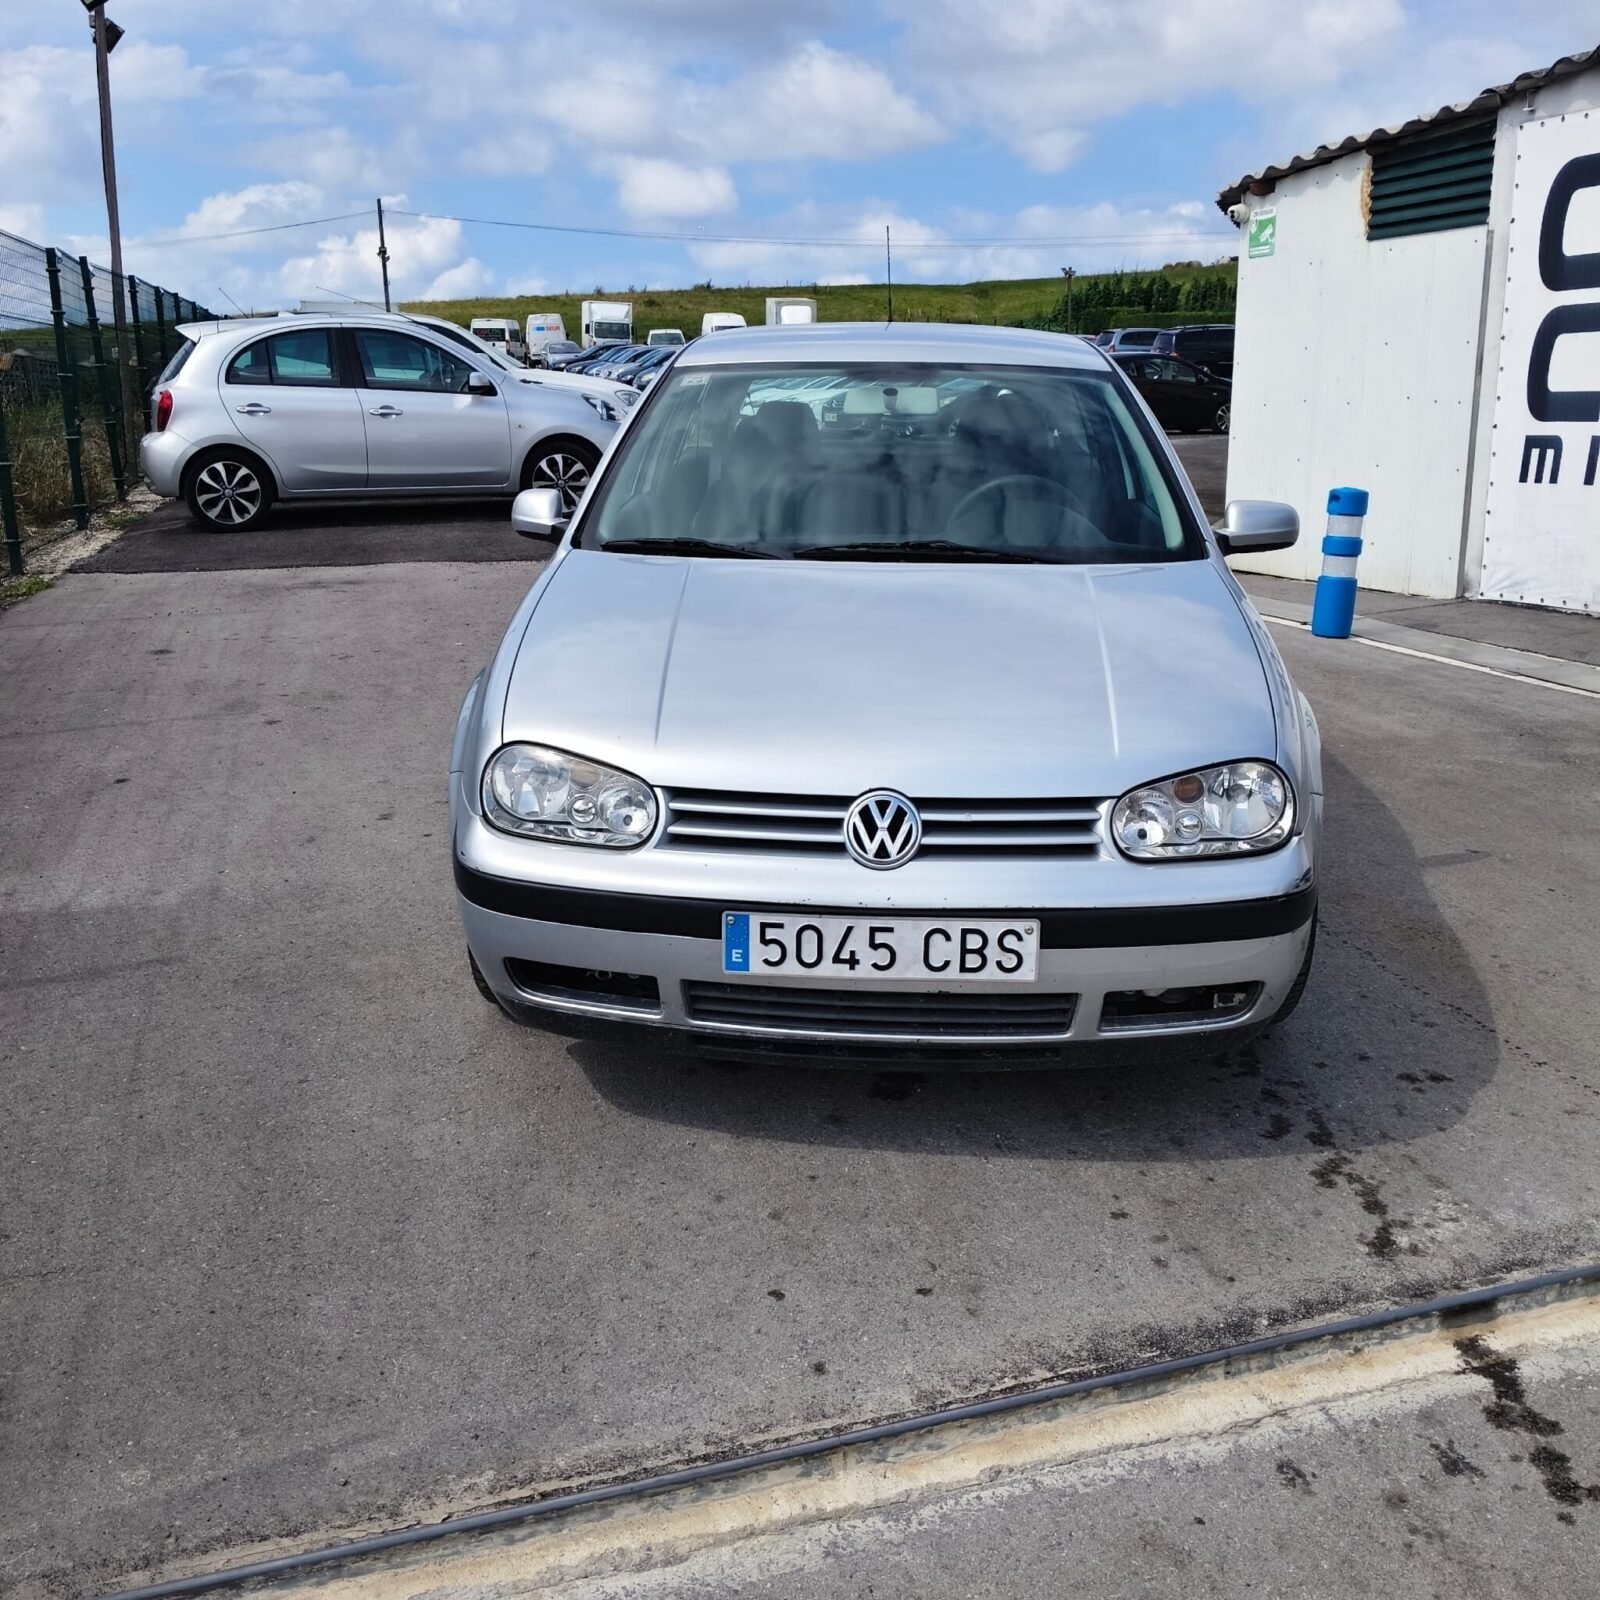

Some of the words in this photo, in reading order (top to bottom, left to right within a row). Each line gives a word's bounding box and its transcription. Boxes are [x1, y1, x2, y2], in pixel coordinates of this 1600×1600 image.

[731, 949, 743, 962] E
[759, 921, 897, 972] 5045
[923, 927, 1024, 974] CBS
